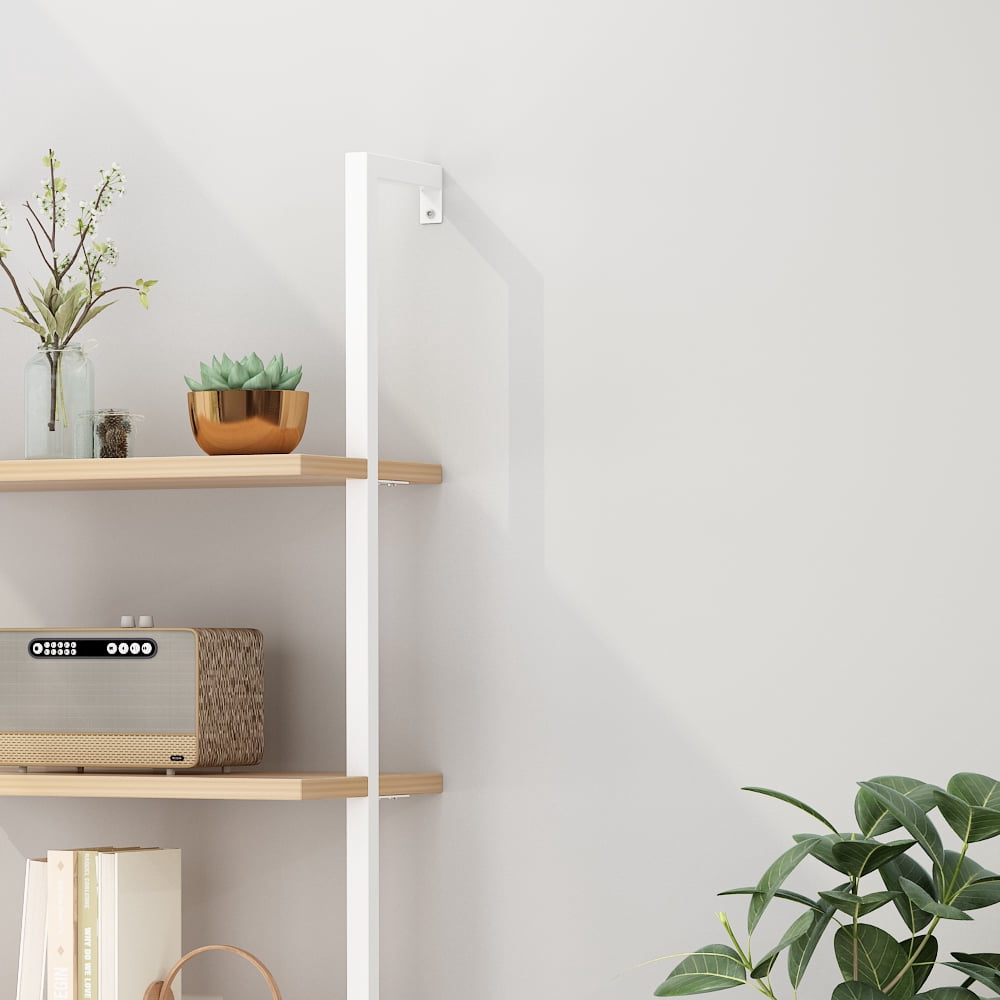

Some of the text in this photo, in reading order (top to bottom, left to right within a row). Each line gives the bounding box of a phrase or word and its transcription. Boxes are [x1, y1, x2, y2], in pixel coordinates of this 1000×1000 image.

[84, 927, 92, 947] WHY
[84, 948, 92, 961] DO
[84, 962, 92, 976] WE
[84, 977, 92, 999] LOVE
